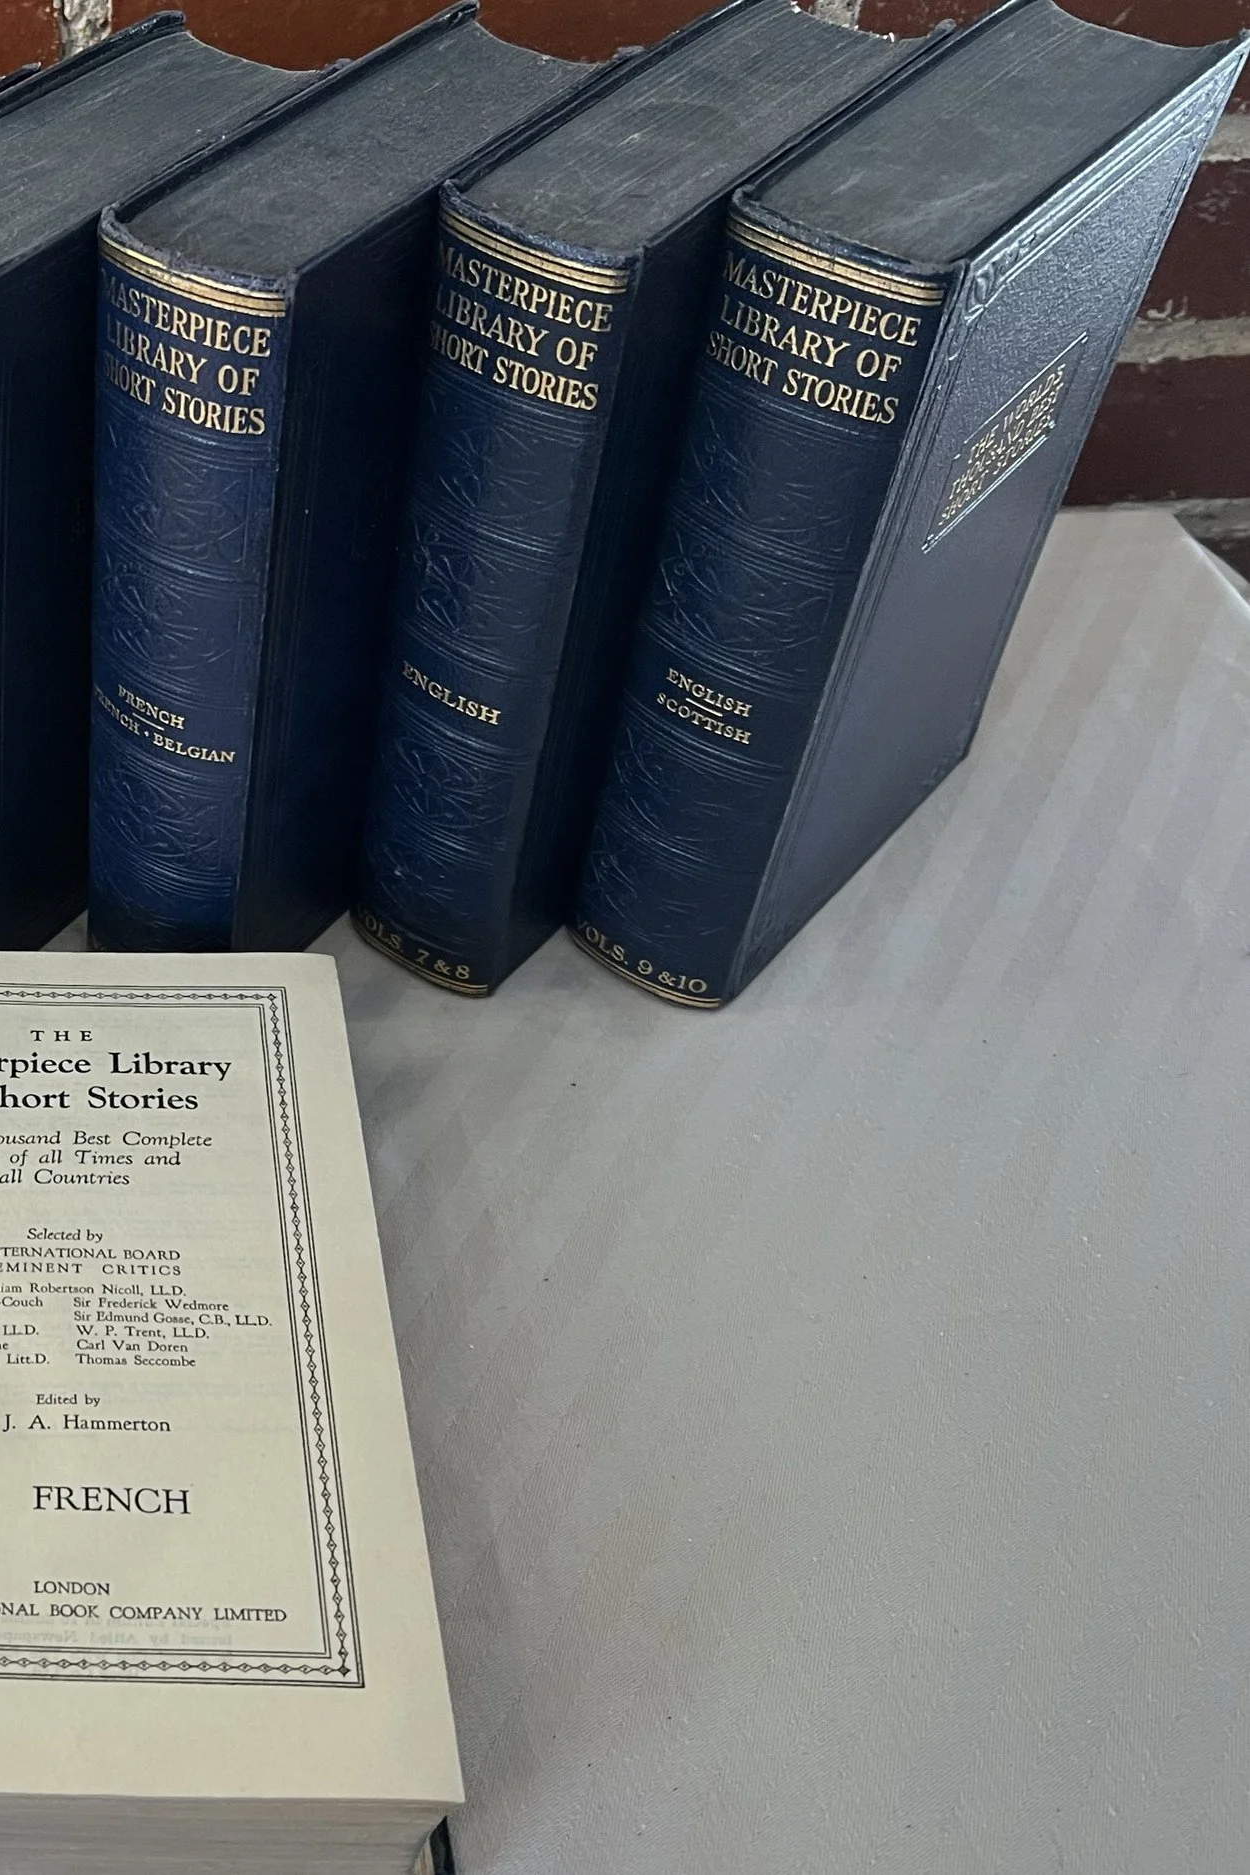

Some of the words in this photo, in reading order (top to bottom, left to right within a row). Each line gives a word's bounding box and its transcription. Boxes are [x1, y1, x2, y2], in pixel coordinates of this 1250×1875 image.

[723, 252, 921, 346] MASTERPIECE
[437, 283, 549, 356] LIBRARY
[556, 337, 598, 370] OF
[720, 295, 851, 367] LIBRARY
[856, 349, 902, 382] OF
[107, 313, 208, 384] LIBRARY
[218, 365, 259, 395] OF
[493, 356, 599, 410] STORIES
[707, 331, 778, 385] SHORT
[783, 369, 898, 424] STORIES
[162, 387, 265, 434] STORIES
[403, 660, 501, 725] ENGLISH
[667, 668, 752, 717] ENGLISH
[118, 684, 185, 729] FRENCH
[657, 693, 751, 744] SCOTTISH
[153, 733, 235, 762] BELGIAN
[414, 949, 430, 965] 7
[434, 959, 450, 975] &
[456, 965, 470, 979] 8
[638, 960, 652, 975] 9
[29, 1029, 93, 1042] THE
[108, 1051, 232, 1082] Library
[87, 1085, 199, 1110] Stories
[73, 1130, 111, 1146] Best
[122, 1130, 213, 1149] Complete
[9, 1149, 29, 1167] of
[38, 1149, 63, 1164] all
[74, 1149, 134, 1165] Times
[144, 1150, 182, 1166] and
[33, 1168, 130, 1186] Countries
[26, 1227, 81, 1241] Selected
[86, 1228, 103, 1244] by
[123, 1249, 181, 1261] BOARD
[102, 1264, 181, 1276] CRITICS
[29, 1282, 95, 1294] Robertson
[101, 1283, 144, 1297] Nicoll,
[73, 1296, 91, 1308] Sir
[98, 1297, 157, 1309] Frederick
[164, 1298, 229, 1312] Wedmore
[73, 1310, 92, 1322] Sir
[96, 1310, 149, 1323] Edmund
[153, 1312, 195, 1326] Gosse,
[198, 1313, 231, 1327] C.B.,
[76, 1324, 98, 1336] W.
[105, 1324, 118, 1337] P.
[123, 1325, 166, 1340] Trent,
[76, 1338, 105, 1351] Carl
[112, 1339, 141, 1351] Van
[147, 1340, 189, 1353] Doren
[74, 1353, 128, 1366] Thomas
[133, 1354, 196, 1367] Seccombe
[36, 1393, 78, 1405] Edited
[84, 1393, 101, 1408] by
[1, 1413, 16, 1433] J.
[27, 1414, 51, 1430] A.
[63, 1414, 171, 1432] Hammerton
[32, 1485, 191, 1515] FRENCH
[33, 1580, 110, 1596] LONDON
[49, 1603, 100, 1619] BOOK
[109, 1605, 203, 1621] COMPANY
[213, 1607, 288, 1622] LIMITED
